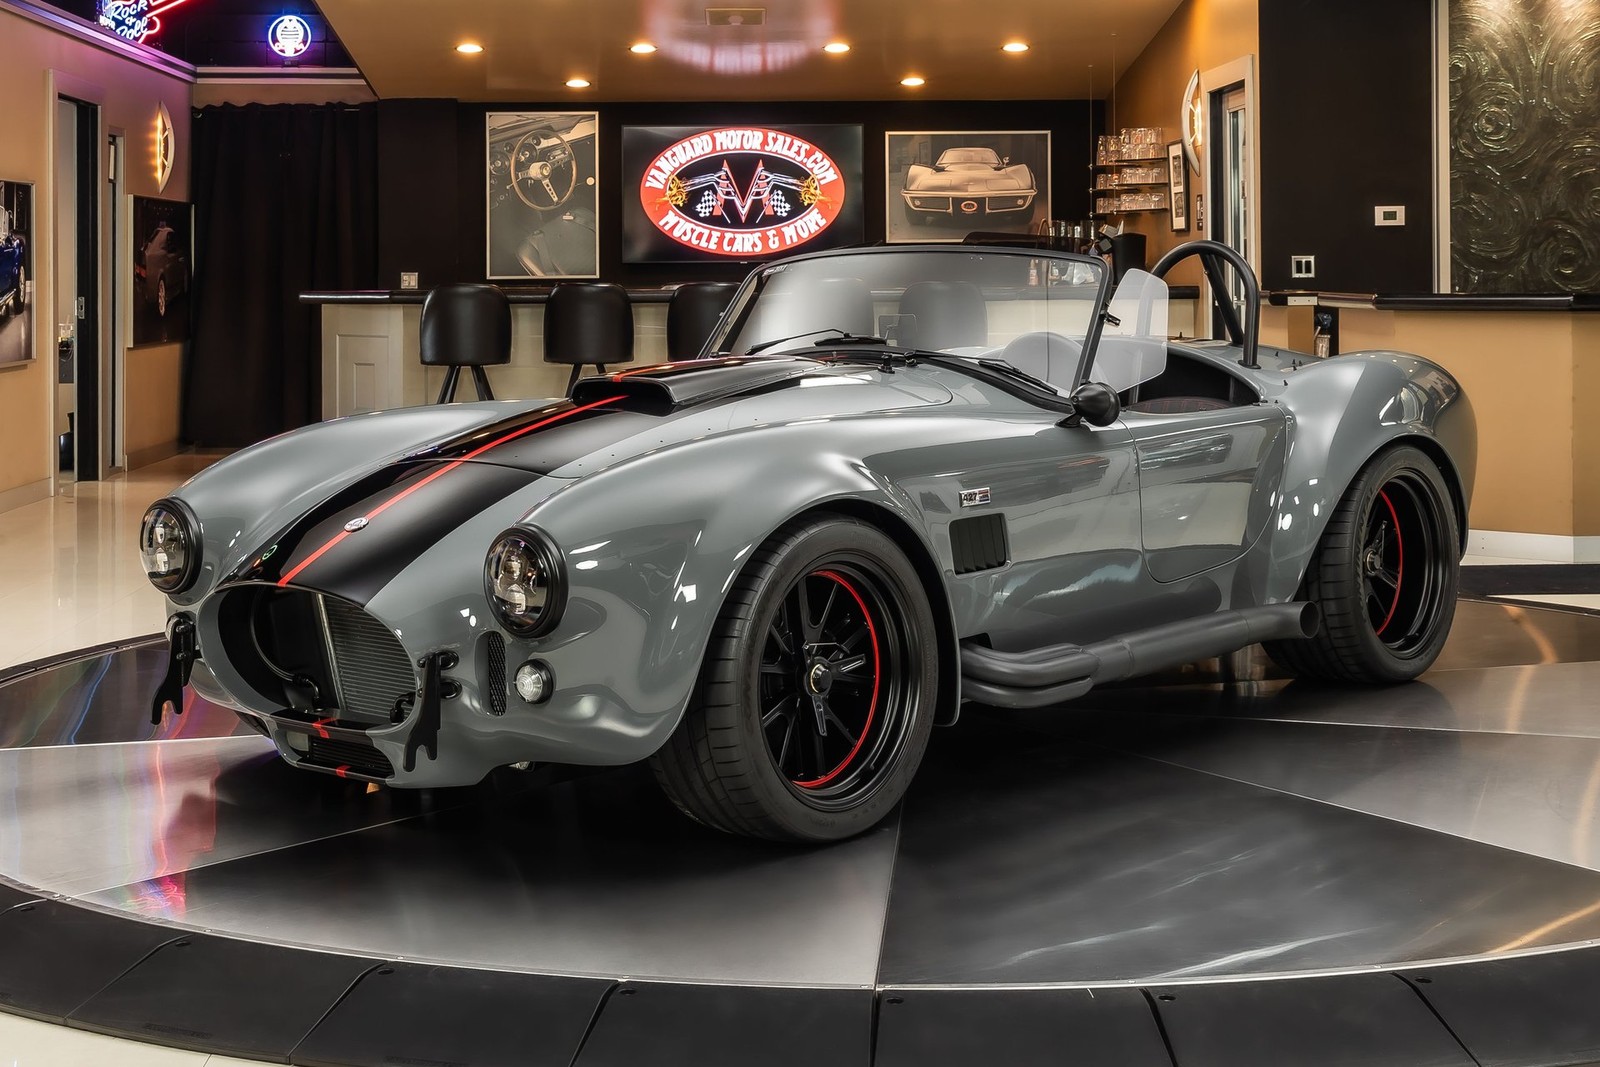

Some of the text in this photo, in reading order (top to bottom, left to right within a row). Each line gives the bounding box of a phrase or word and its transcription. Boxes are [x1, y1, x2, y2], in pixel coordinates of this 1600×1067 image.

[110, 0, 148, 20] Rock
[645, 129, 839, 190] VANGUARD MOTOR SALES.COM
[658, 208, 828, 253] MUSCLE CARS & MORE
[963, 492, 977, 502] 427
